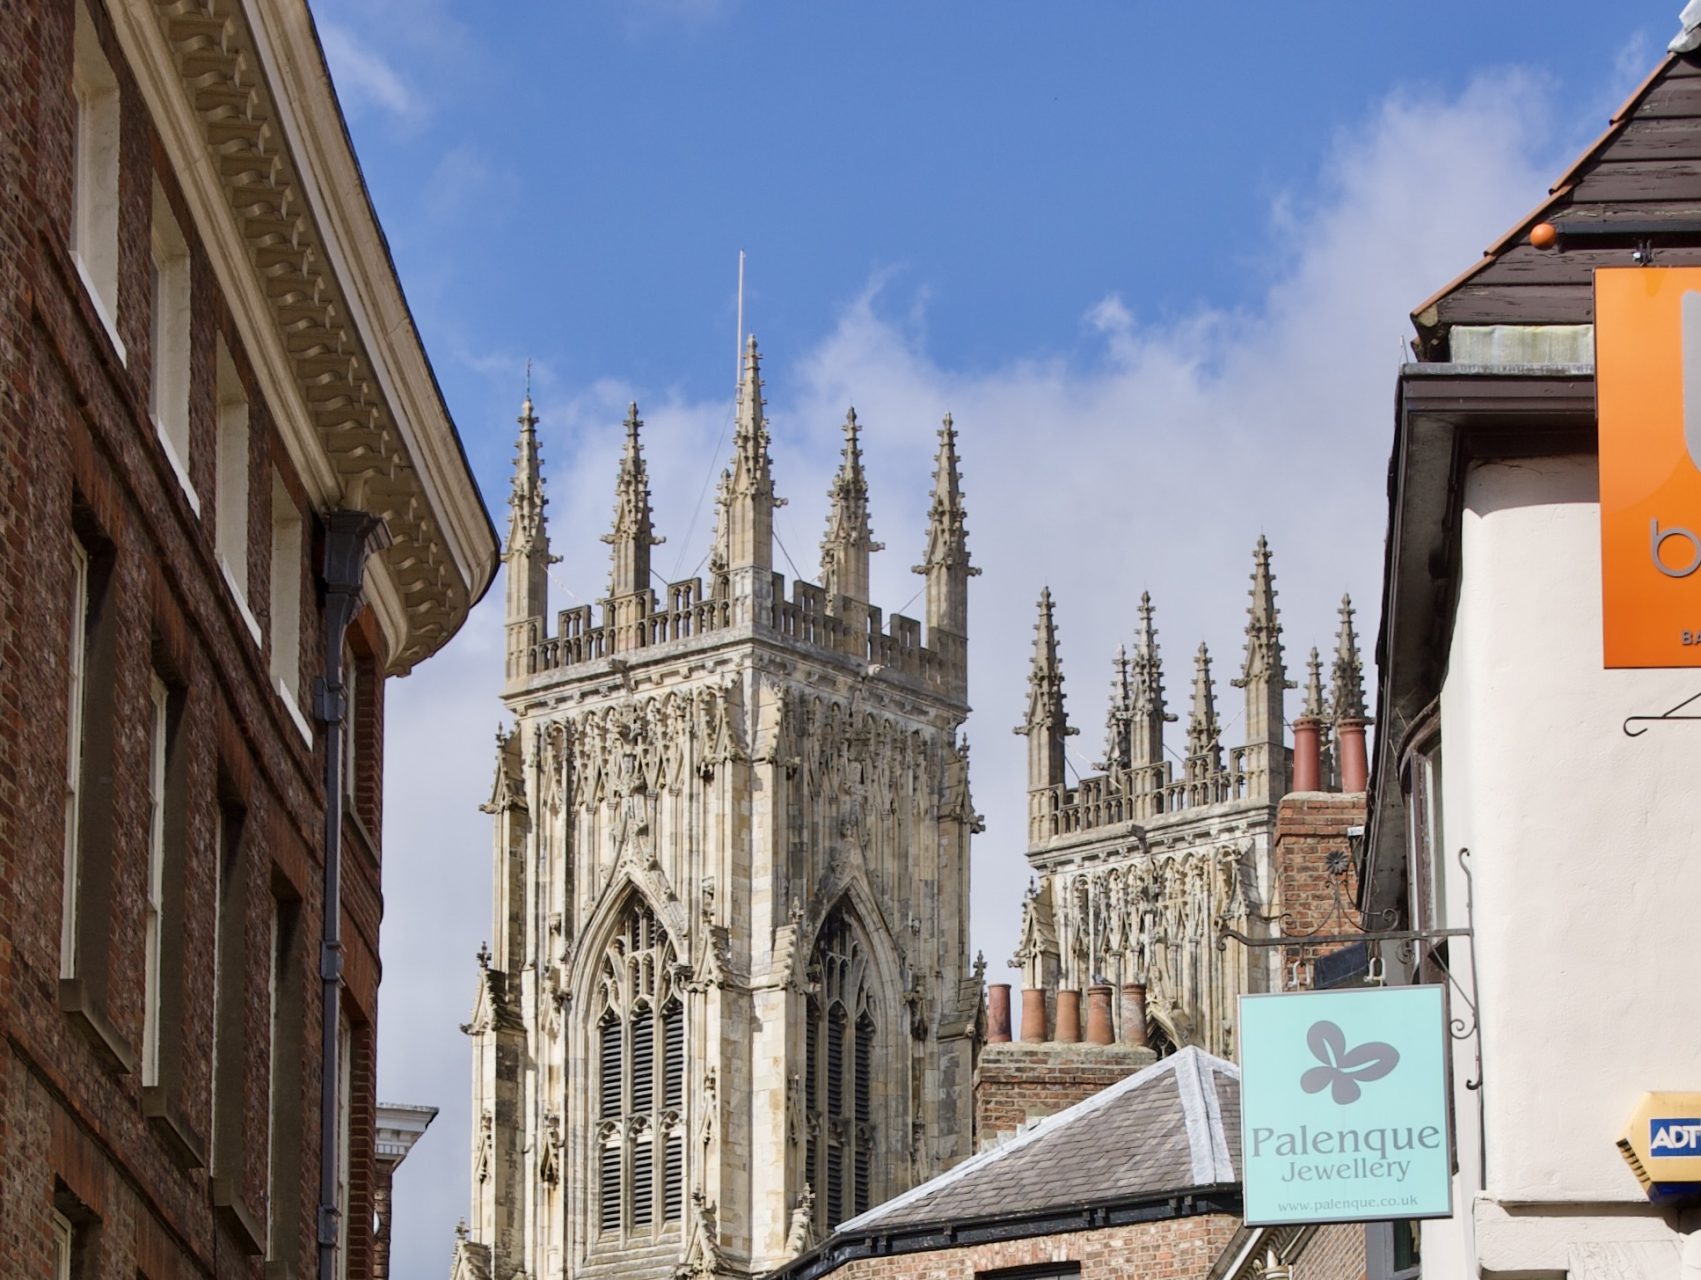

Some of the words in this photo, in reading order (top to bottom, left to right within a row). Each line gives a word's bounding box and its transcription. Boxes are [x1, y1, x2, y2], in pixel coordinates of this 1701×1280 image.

[1252, 1125, 1440, 1160] Palenque
[1651, 1125, 1701, 1149] ADT
[1281, 1158, 1411, 1182] Jewellery
[1278, 1195, 1418, 1212] www.palenque.co.uk
